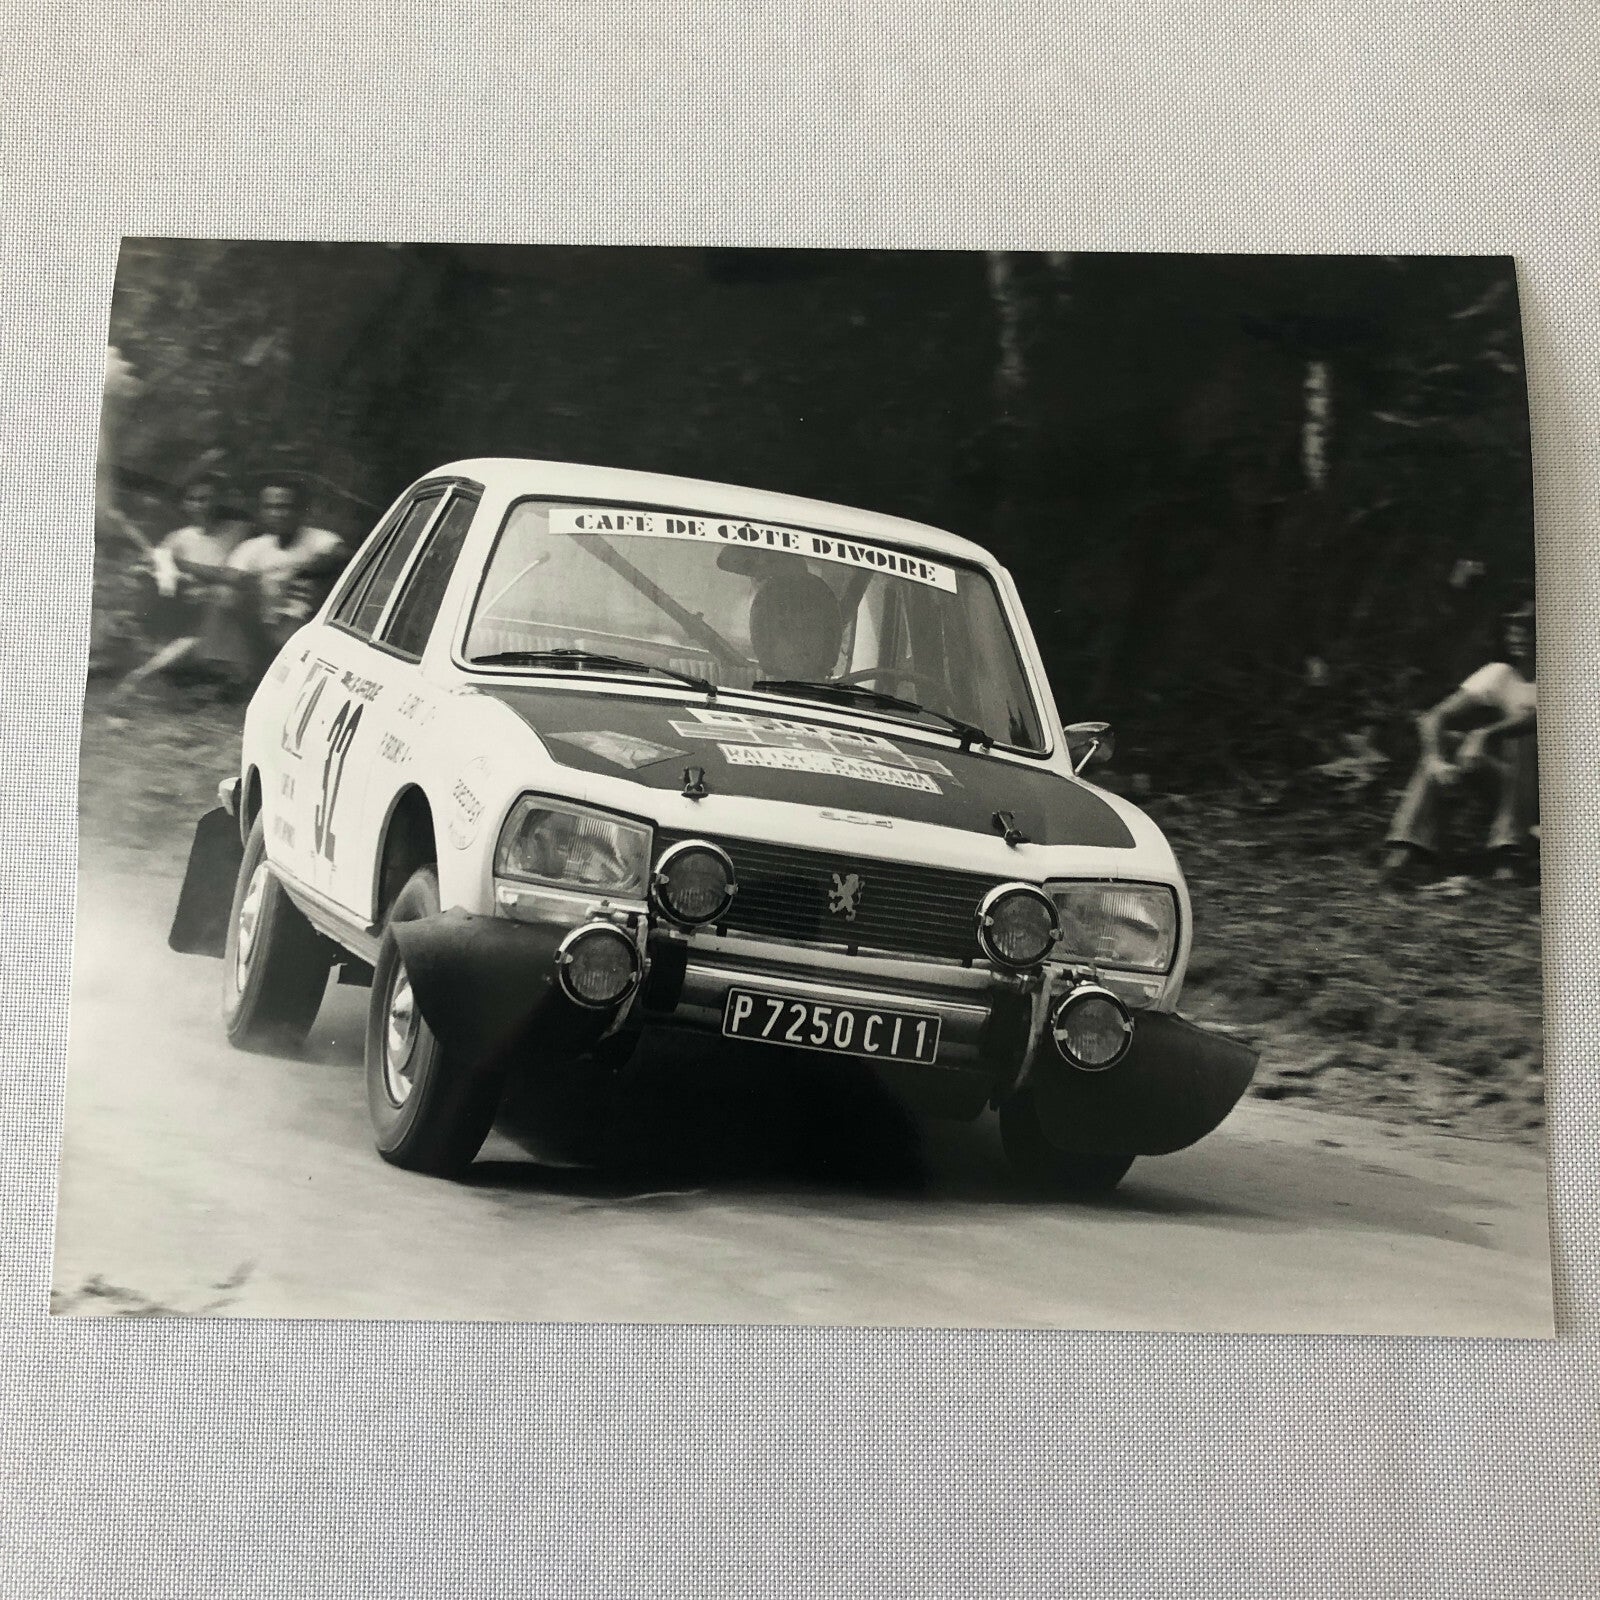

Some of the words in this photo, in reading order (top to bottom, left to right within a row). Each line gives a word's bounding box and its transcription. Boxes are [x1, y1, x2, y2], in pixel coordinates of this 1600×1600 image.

[574, 512, 654, 533] CAFÉ
[666, 518, 706, 537] DE
[717, 521, 801, 550] CÔTE
[812, 538, 936, 582] D'IVOIRE
[731, 994, 754, 1034] P
[761, 999, 855, 1048] 7250
